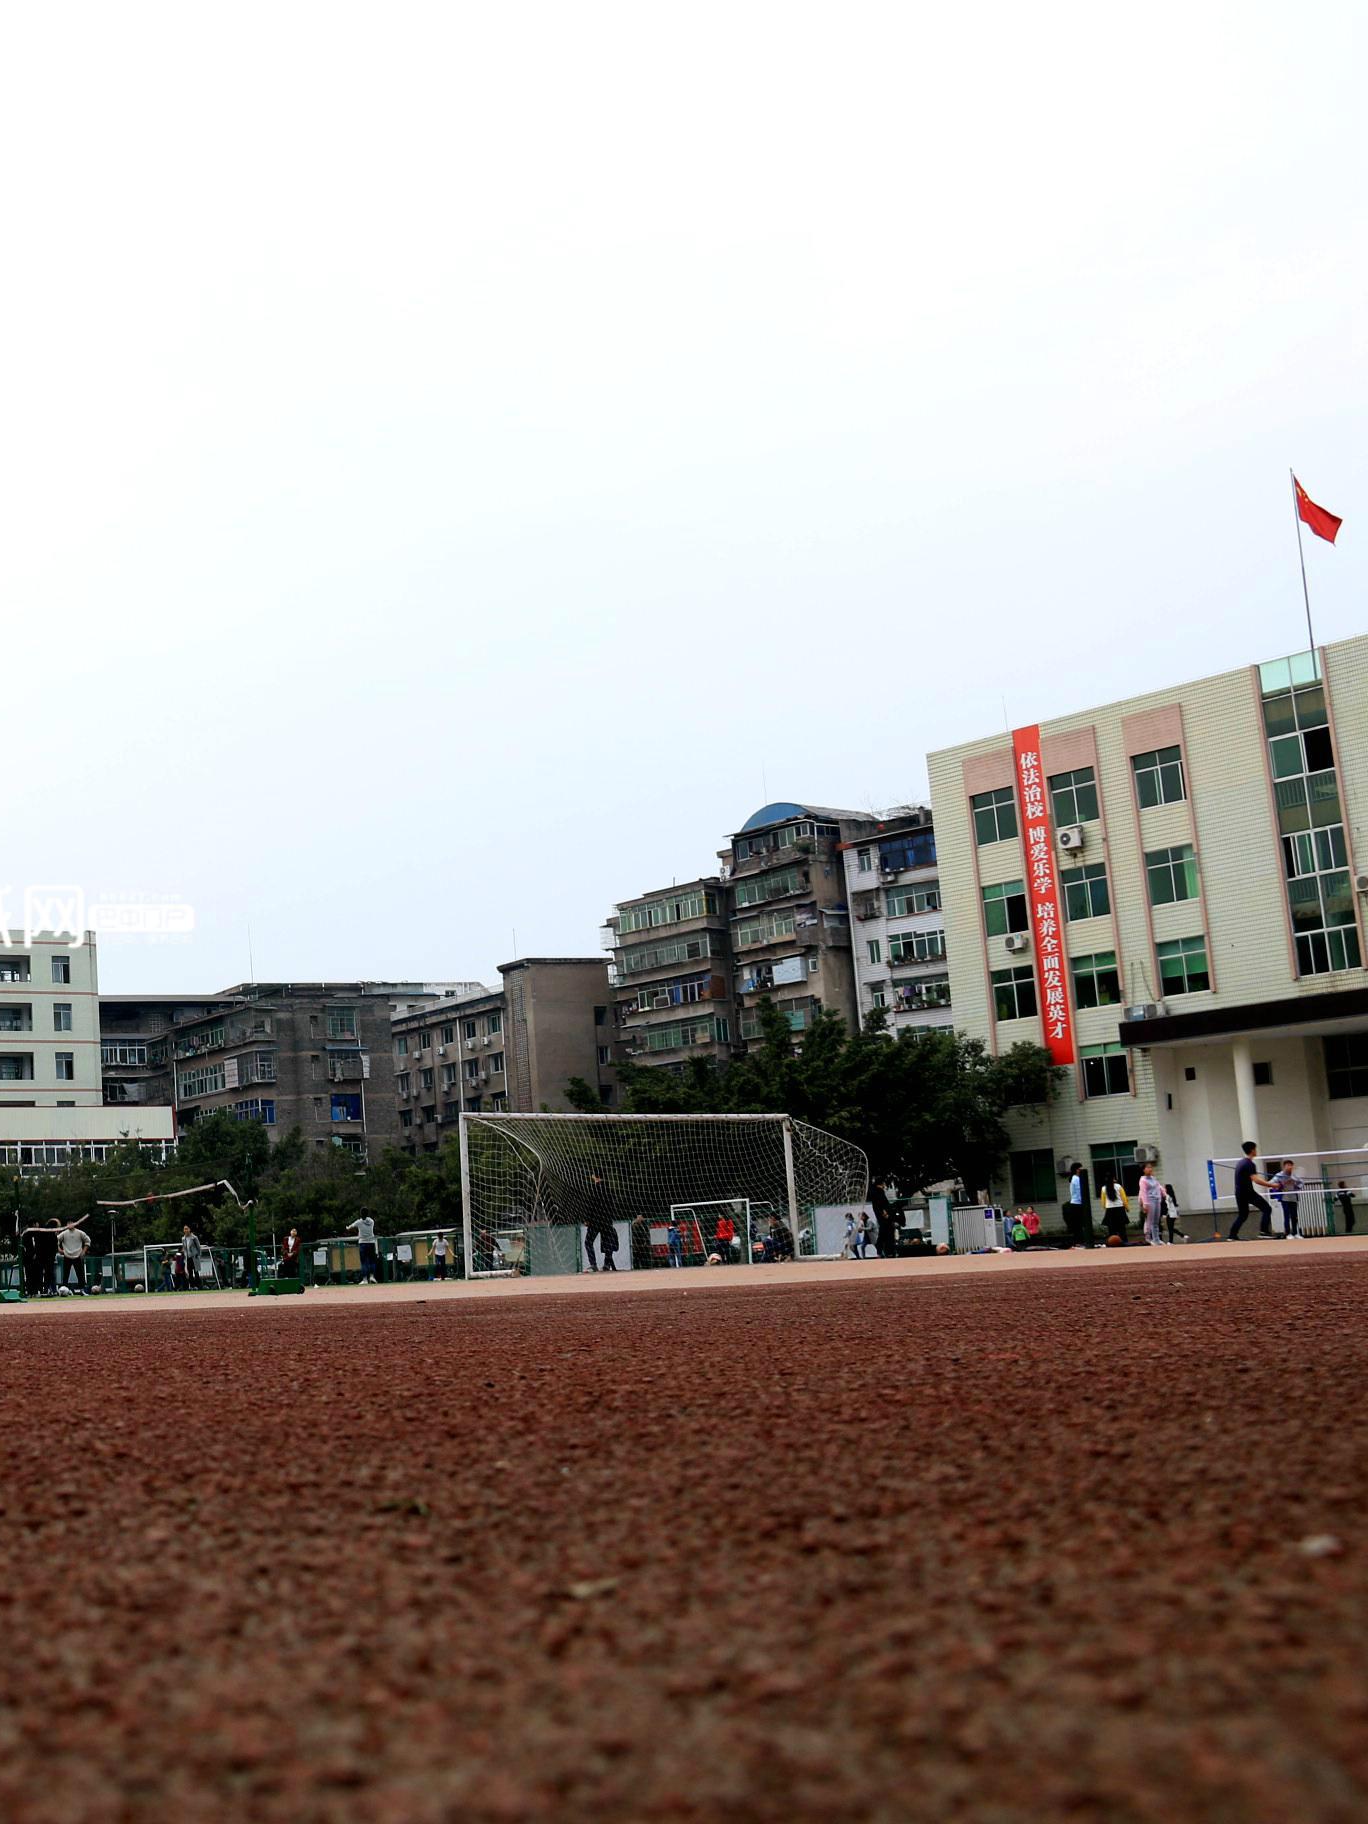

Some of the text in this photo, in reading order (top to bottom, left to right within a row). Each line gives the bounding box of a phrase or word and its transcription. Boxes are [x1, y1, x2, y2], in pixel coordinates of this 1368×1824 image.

[1020, 752, 1067, 1039] 依法治校 博爱乐学 培养全面发展英才
